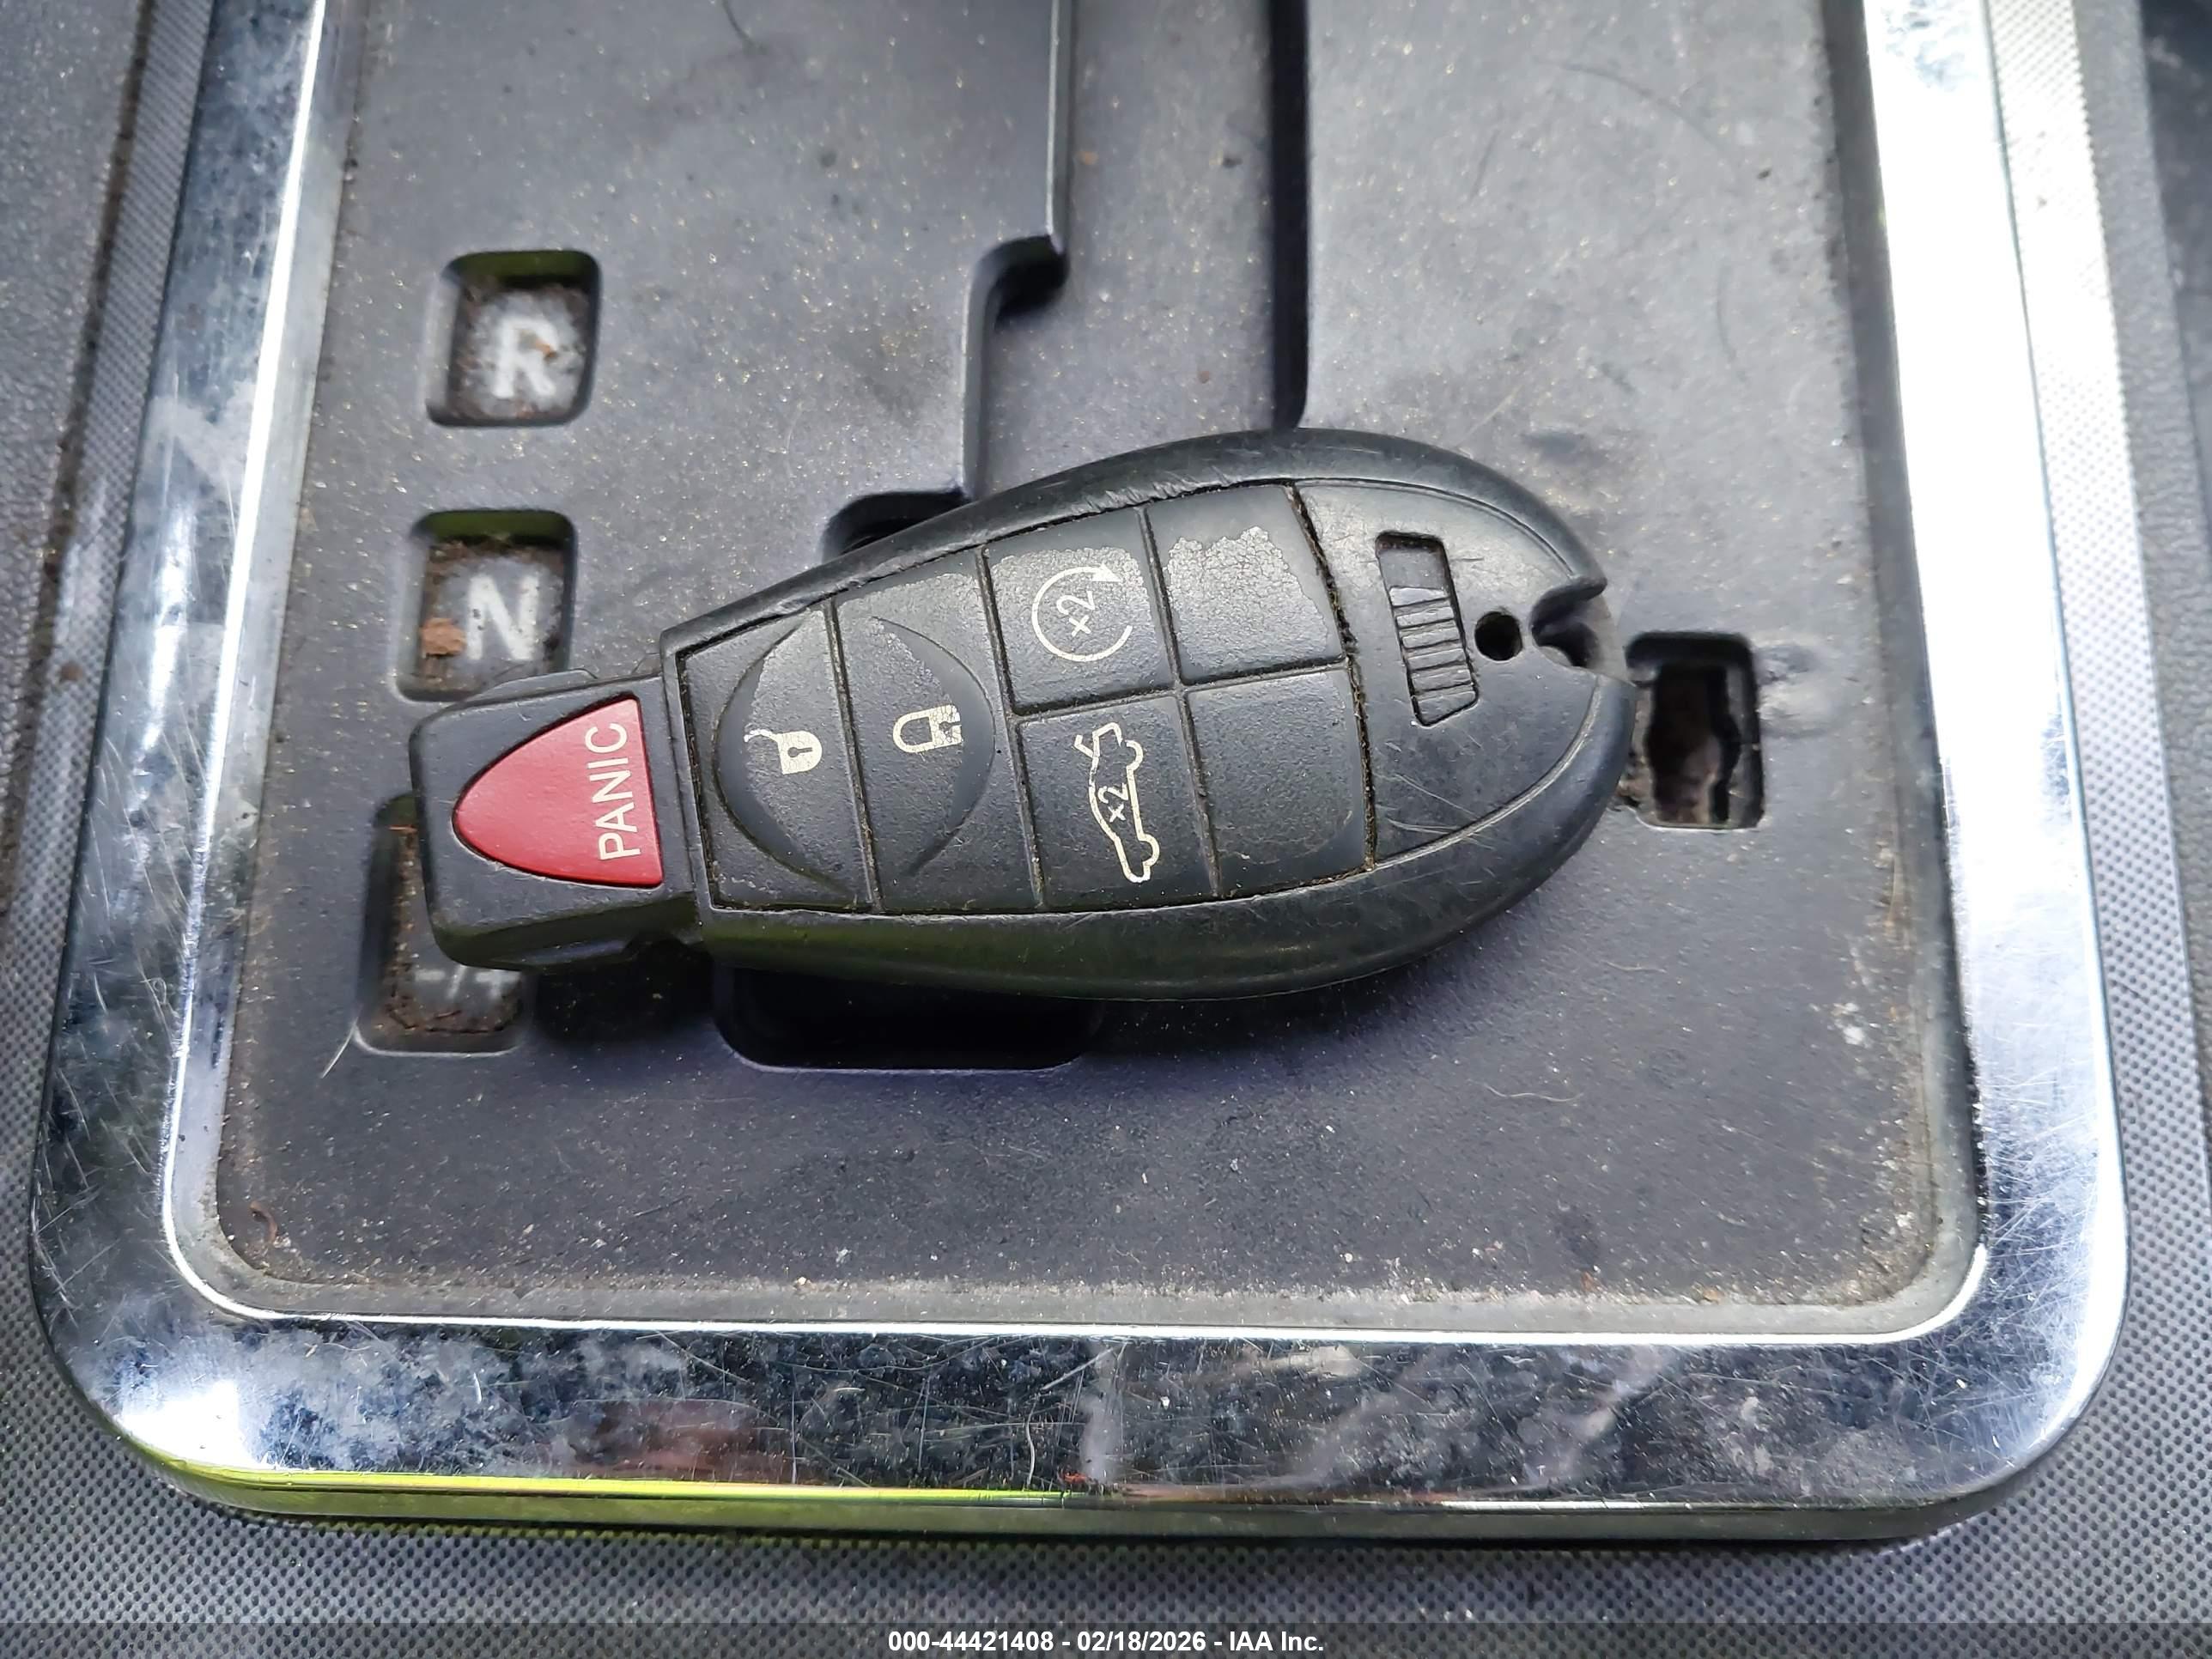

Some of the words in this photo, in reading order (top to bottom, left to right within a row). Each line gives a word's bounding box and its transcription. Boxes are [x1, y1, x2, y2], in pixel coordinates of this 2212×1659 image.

[490, 315, 562, 400] R
[465, 574, 540, 661] N
[585, 721, 641, 861] PANIC
